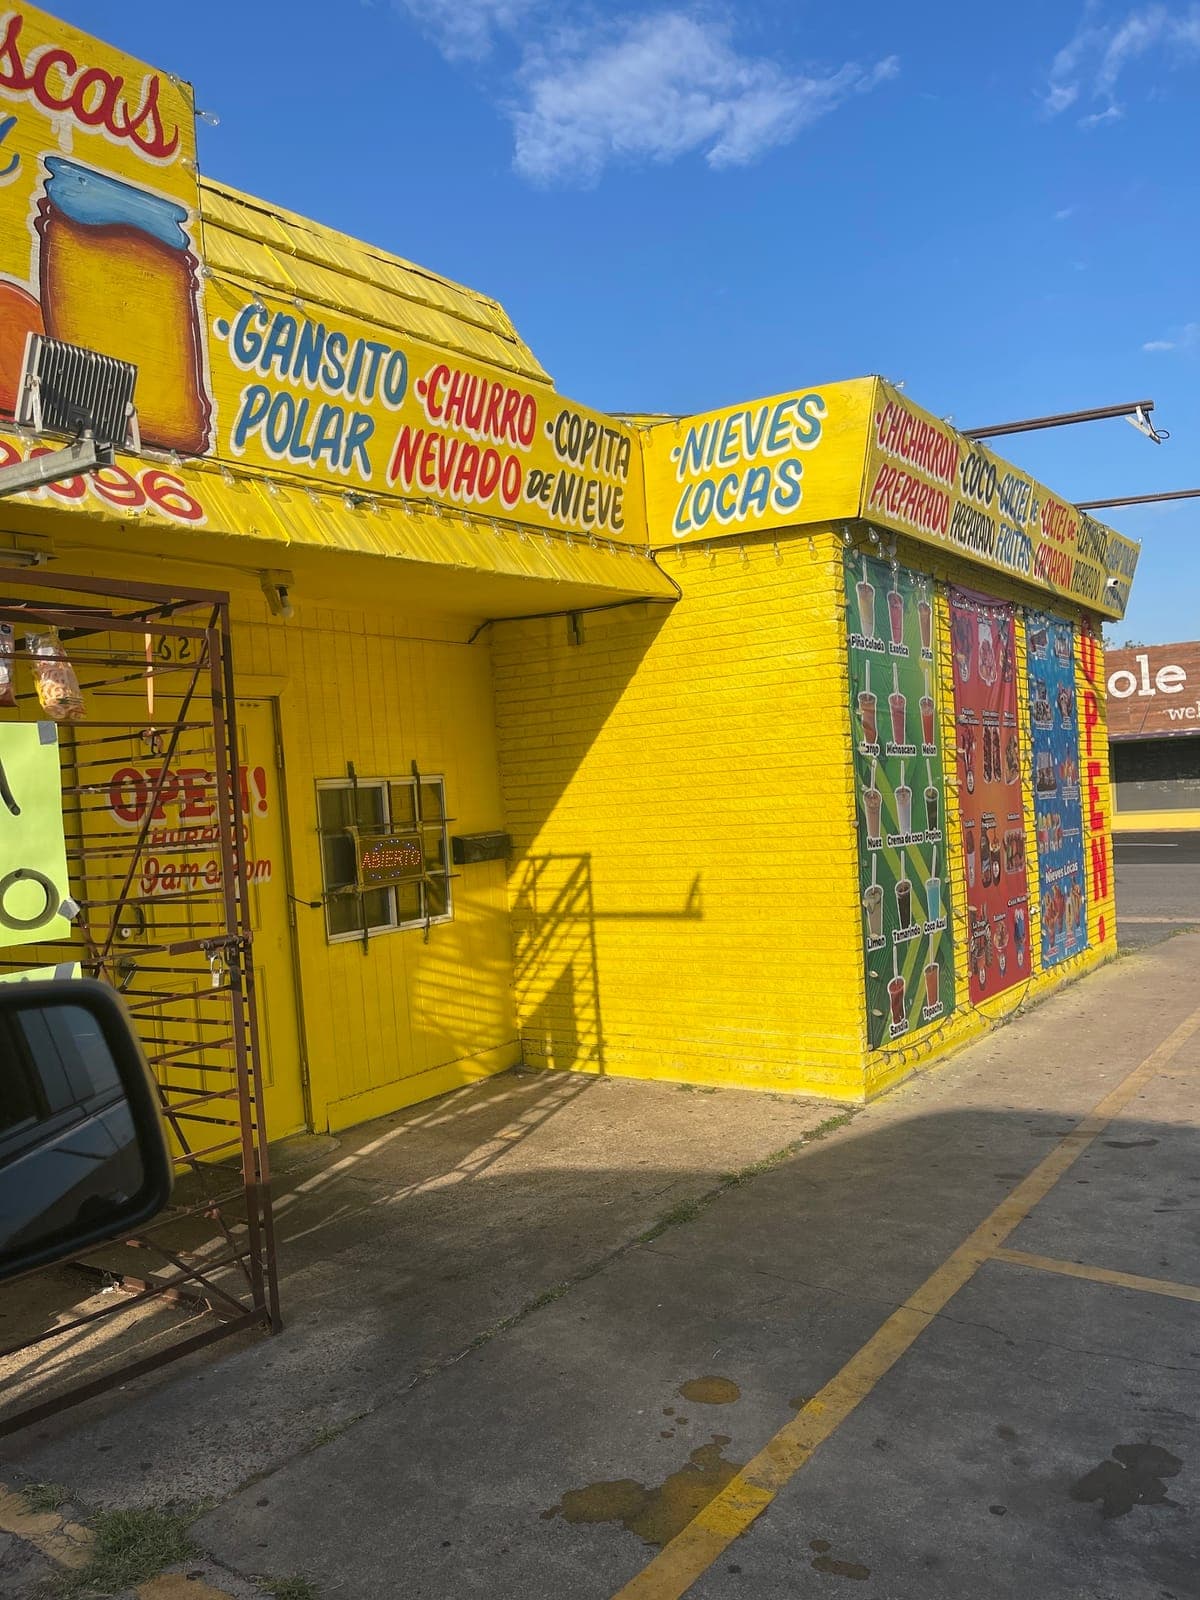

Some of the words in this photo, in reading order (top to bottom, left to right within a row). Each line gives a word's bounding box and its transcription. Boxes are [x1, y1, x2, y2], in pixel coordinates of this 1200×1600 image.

[233, 302, 408, 402] GANSITO
[235, 385, 375, 475] POLAR
[426, 365, 538, 446] CHURRO
[679, 394, 826, 476] NIEVES
[390, 425, 522, 505] NEVADO
[554, 410, 631, 479] COPITA
[878, 401, 959, 486] CHICHARRON
[528, 470, 551, 501] DE
[552, 470, 625, 530] NIEVE
[675, 458, 803, 531] LOCAS
[870, 463, 950, 535] PREPARADO
[964, 453, 997, 505] COCO
[951, 501, 995, 555] PREPARADO
[996, 523, 1032, 573] FRUTAS
[1042, 498, 1069, 544] COCTEL
[1034, 542, 1073, 590] CAMARON
[865, 636, 885, 653] Colada
[1045, 866, 1064, 884] Nieves
[1063, 861, 1079, 875] Locas
[893, 925, 920, 943] Tamarindo
